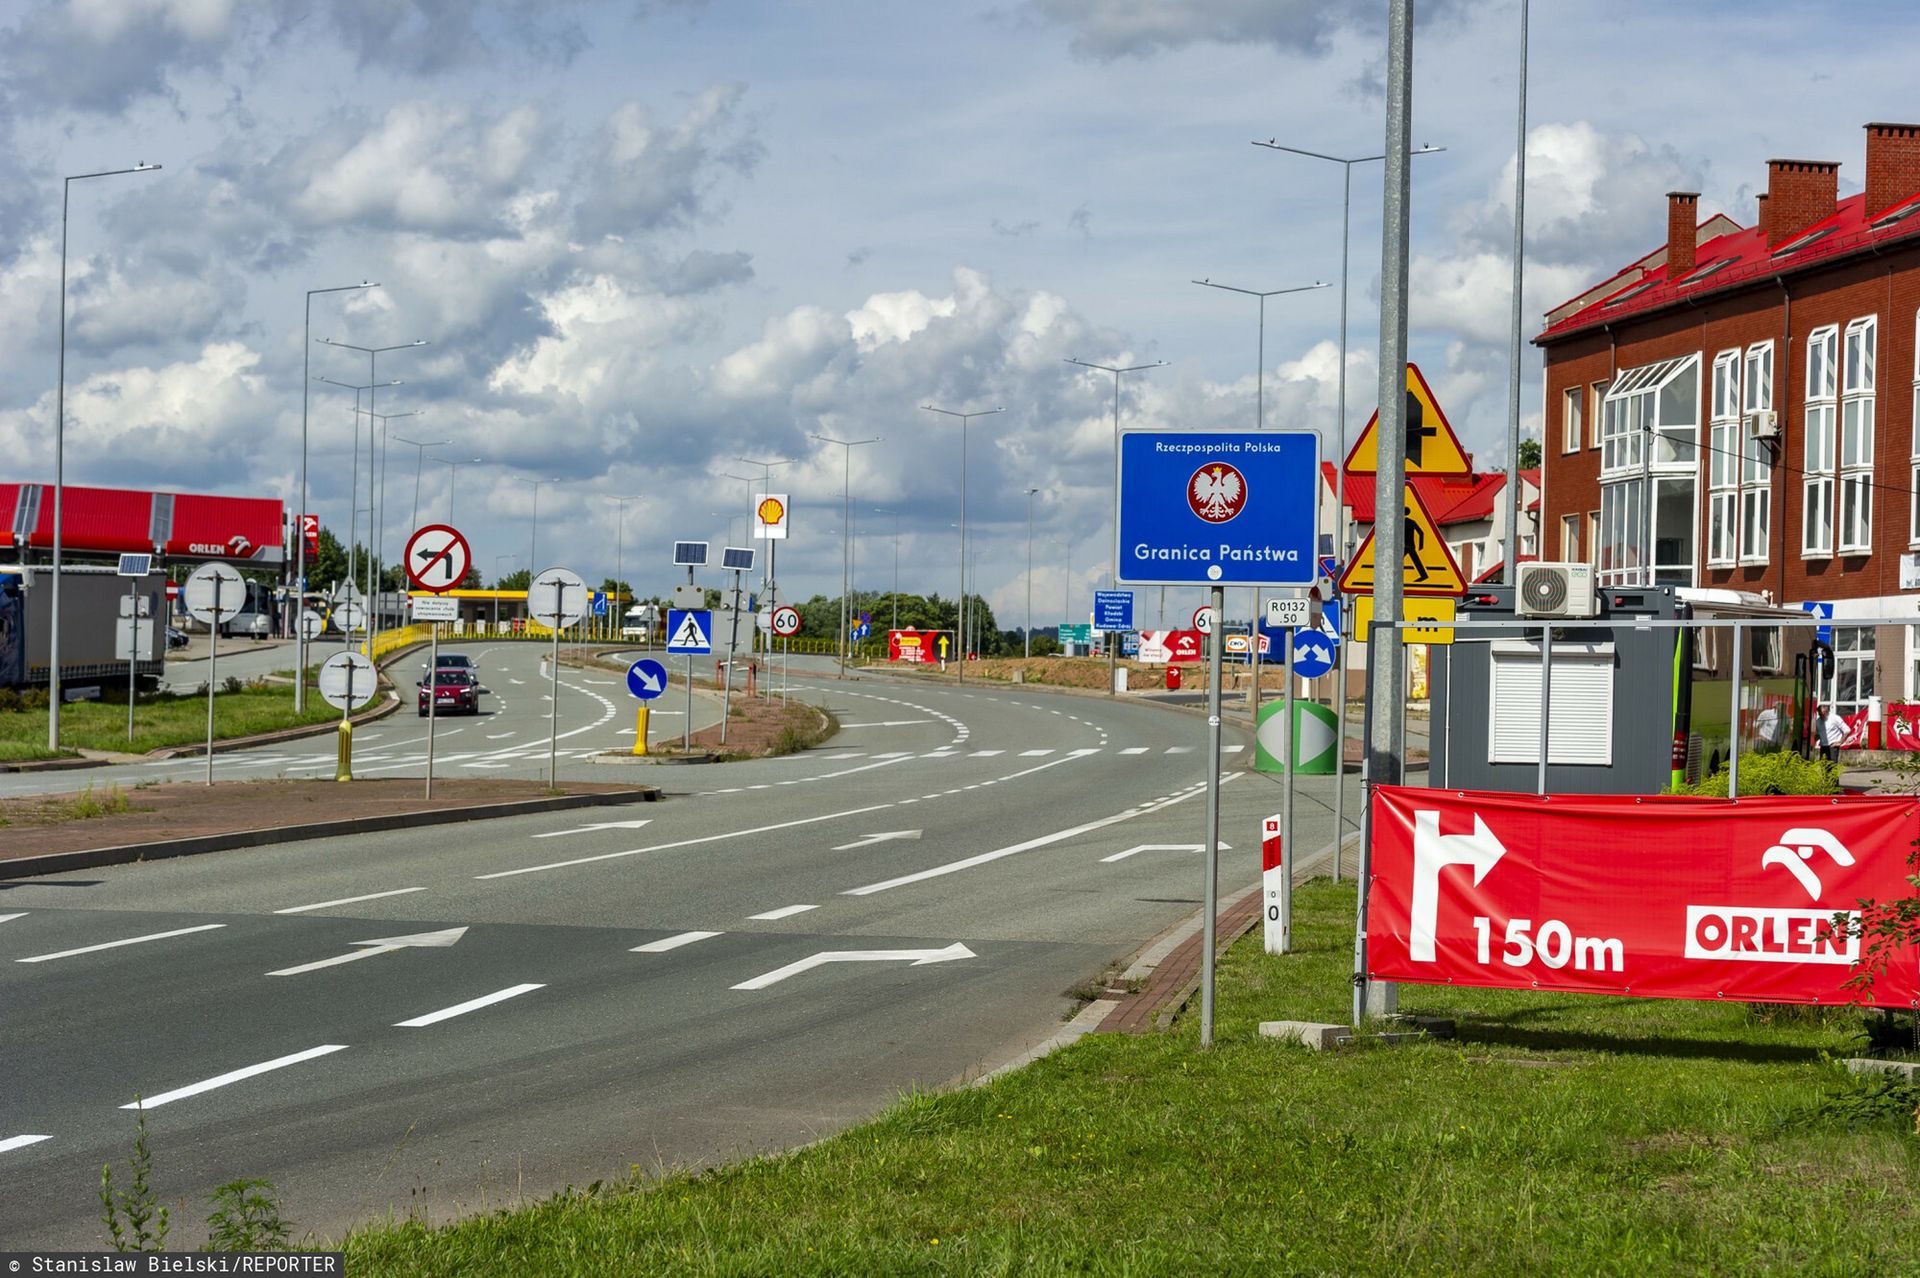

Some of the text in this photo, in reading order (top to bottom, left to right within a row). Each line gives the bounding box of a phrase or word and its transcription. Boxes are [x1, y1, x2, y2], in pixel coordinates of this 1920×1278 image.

[1155, 441, 1281, 455] Rzeczpospolita Polska
[189, 543, 225, 555] ORLEN
[1134, 543, 1298, 562] Granica Państwa
[1272, 601, 1306, 612] R0132
[776, 613, 797, 628] 60
[1197, 612, 1211, 628] 6
[1279, 613, 1297, 624] .50
[1269, 905, 1279, 921] 0
[1695, 914, 1848, 956] ORLEN
[1473, 916, 1624, 972] 150m
